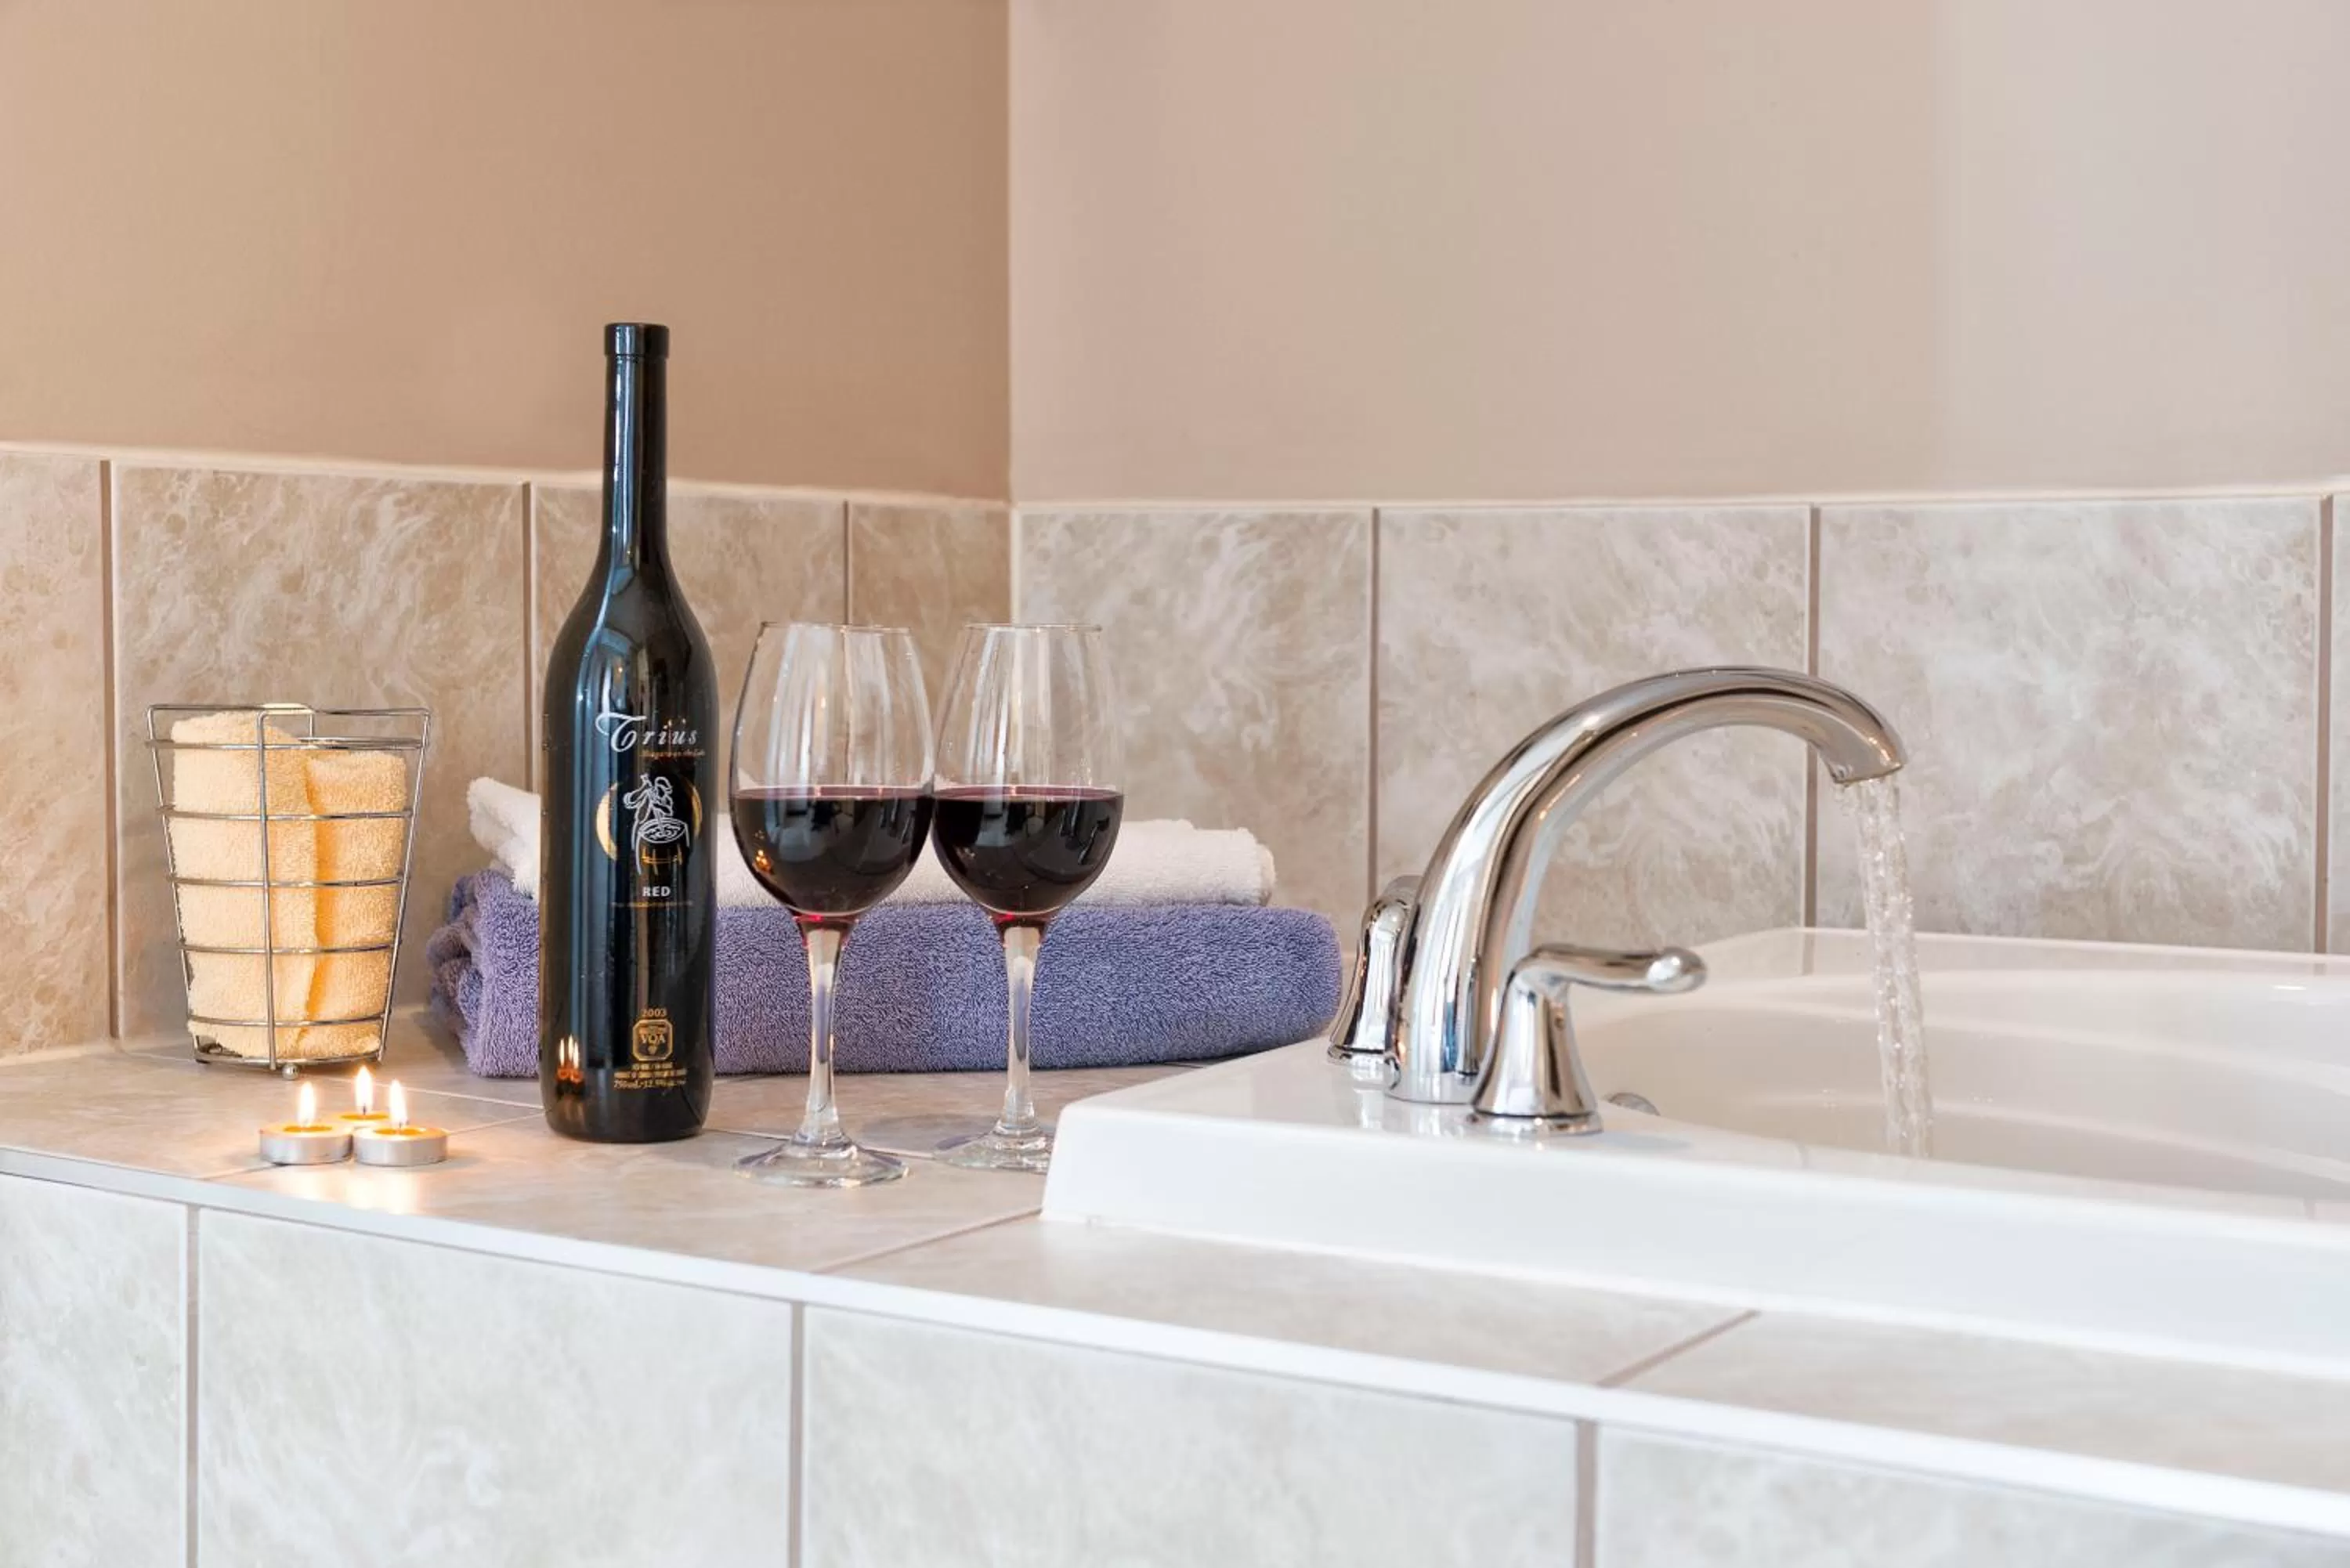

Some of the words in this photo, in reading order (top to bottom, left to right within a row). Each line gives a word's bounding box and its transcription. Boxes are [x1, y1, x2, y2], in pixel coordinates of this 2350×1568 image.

[595, 712, 697, 752] Trius
[642, 886, 671, 897] RED
[642, 1008, 667, 1017] 2003
